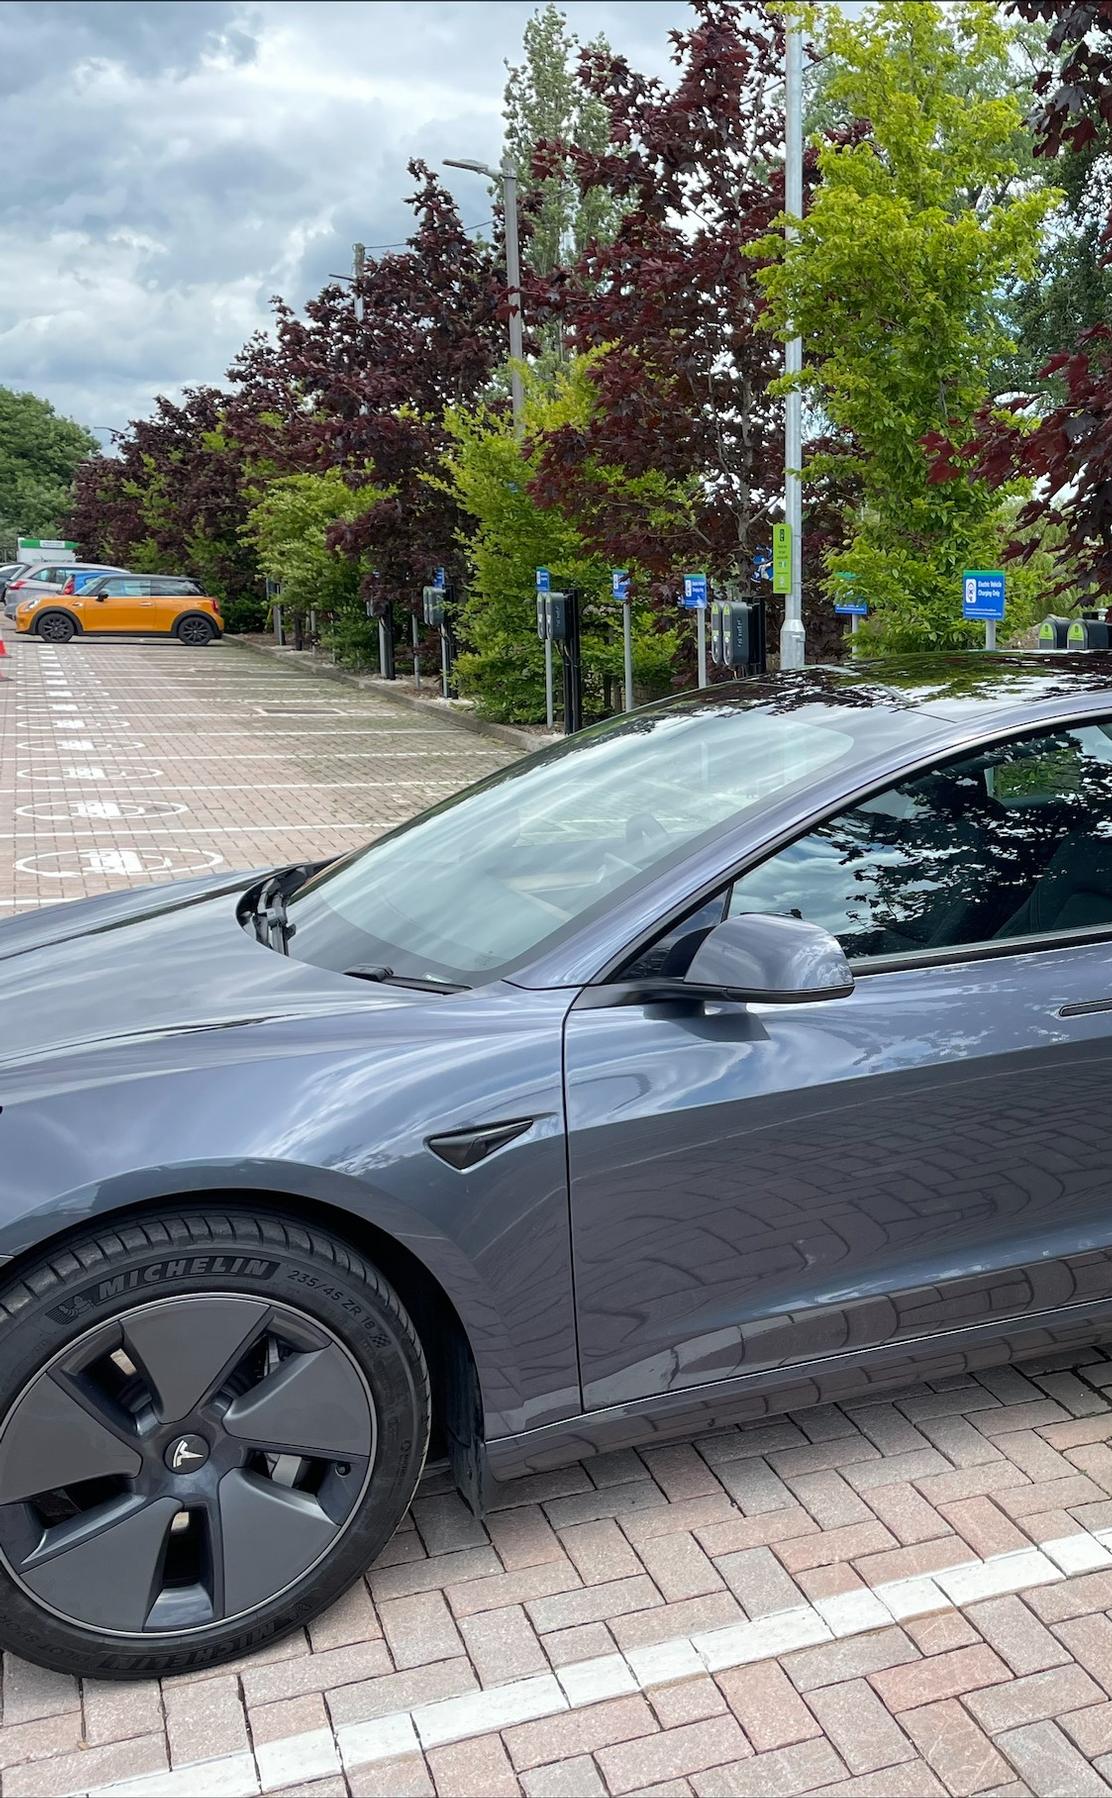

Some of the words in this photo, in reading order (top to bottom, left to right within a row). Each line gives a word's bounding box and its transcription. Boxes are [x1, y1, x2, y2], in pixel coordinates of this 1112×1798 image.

[99, 1257, 278, 1296] MICHELIN
[287, 1269, 344, 1302] 235/45
[341, 1299, 362, 1319] ZR
[361, 1315, 376, 1330] 18
[104, 1622, 275, 1671] MICHELIN
